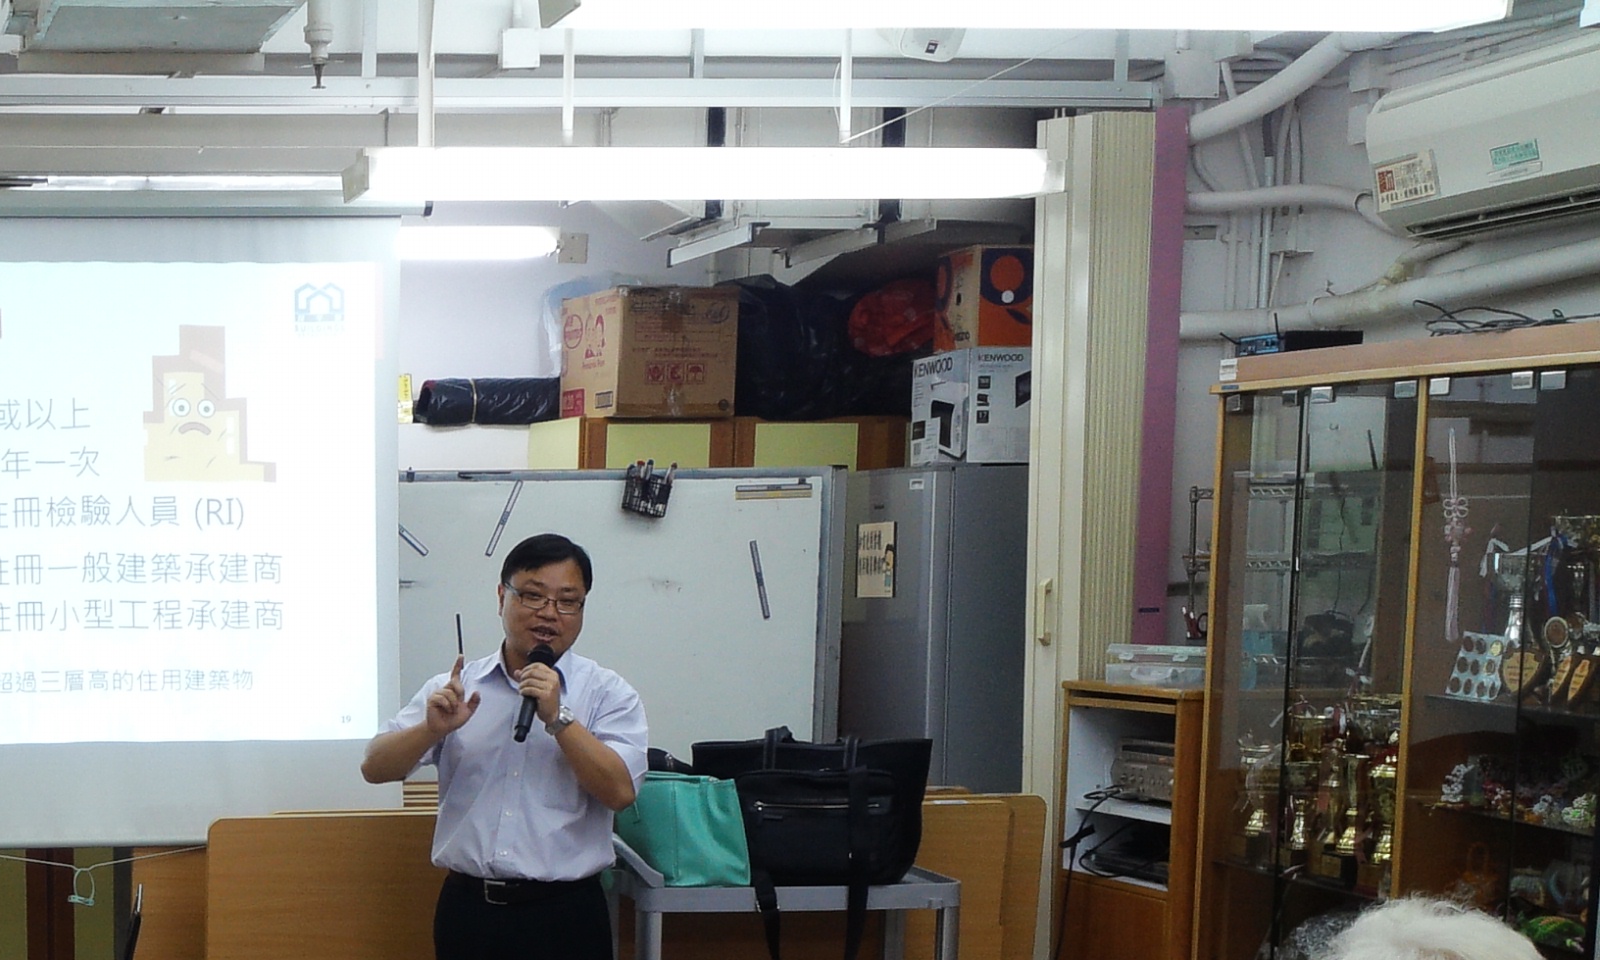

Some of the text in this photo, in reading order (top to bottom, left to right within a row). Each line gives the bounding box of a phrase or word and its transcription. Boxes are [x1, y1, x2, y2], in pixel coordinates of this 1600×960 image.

[913, 357, 953, 378] KENWOOD
[978, 353, 1024, 362] KENWOOD
[1, 446, 101, 480] 年一次
[194, 496, 245, 530] (RI)
[341, 715, 352, 723] 19
